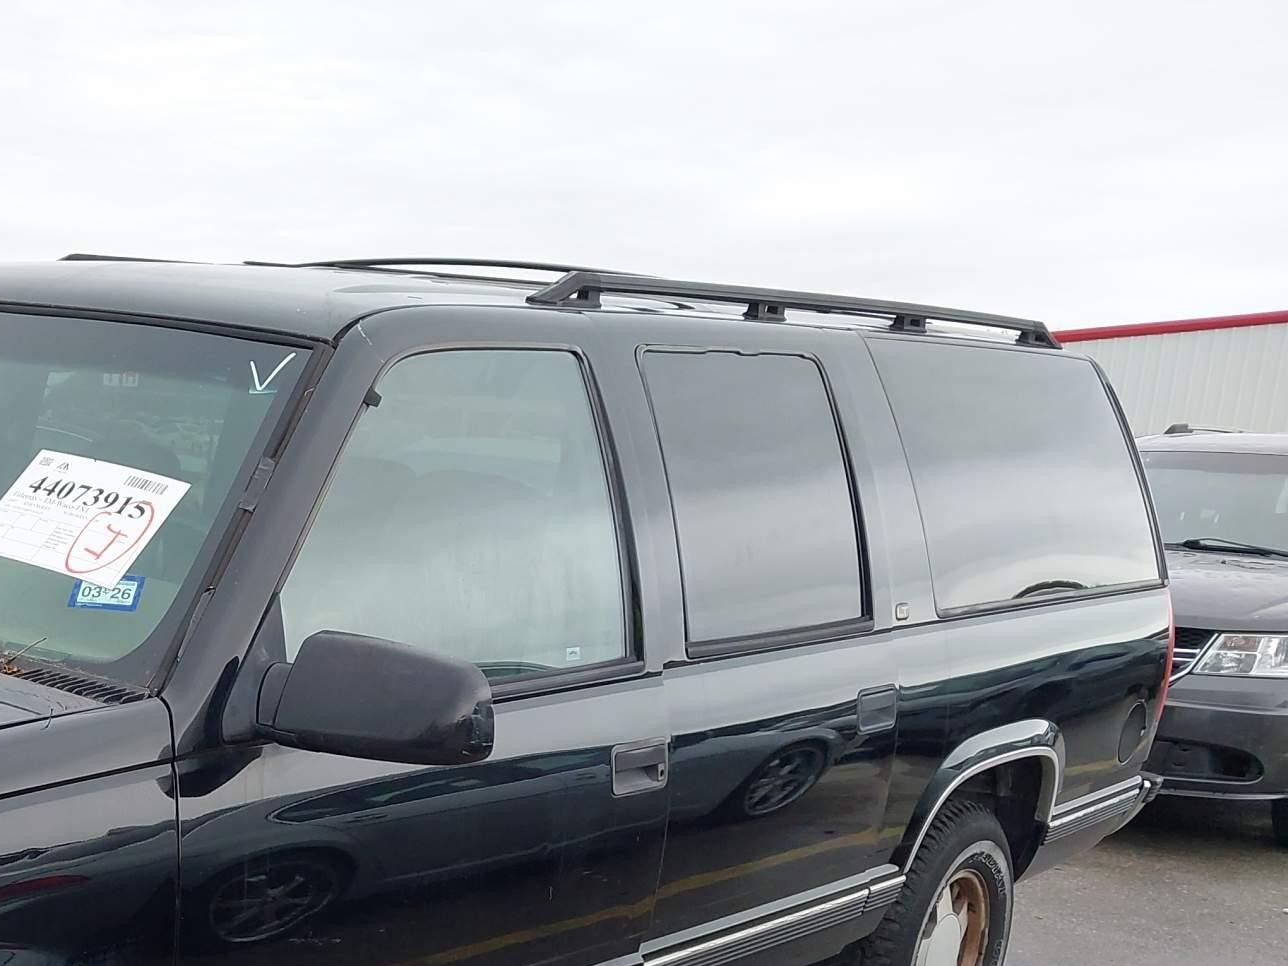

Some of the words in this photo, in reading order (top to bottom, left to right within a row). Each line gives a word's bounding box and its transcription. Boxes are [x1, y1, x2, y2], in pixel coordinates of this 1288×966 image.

[28, 476, 147, 519] 44073915
[81, 585, 103, 598] 03
[109, 587, 133, 600] 26
